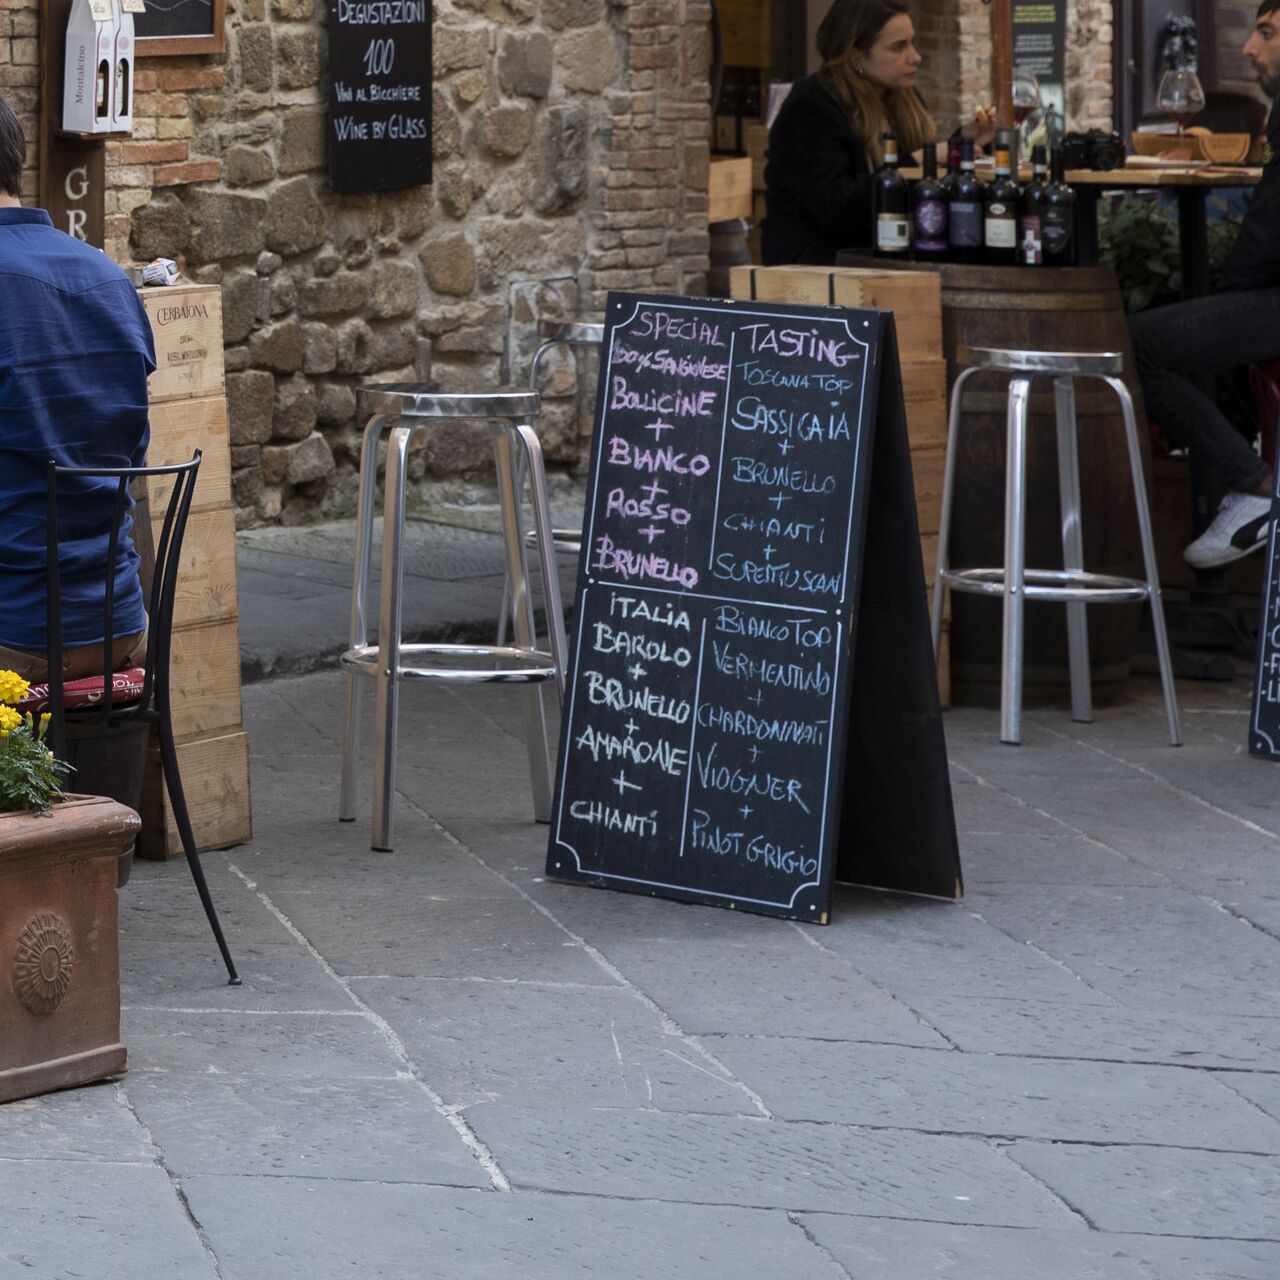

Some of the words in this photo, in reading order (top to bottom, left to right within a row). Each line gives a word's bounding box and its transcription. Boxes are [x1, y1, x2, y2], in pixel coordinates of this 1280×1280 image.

[74, 44, 86, 105] Montalcino
[363, 39, 395, 75] 100
[356, 86, 367, 101] AL
[370, 84, 421, 102] BICCHIERE
[334, 116, 368, 141] WINE
[372, 121, 387, 141] BY
[390, 115, 427, 139] GLASS
[156, 304, 209, 326] CERBAIONA
[629, 311, 726, 347] SPECIAL
[739, 323, 860, 367] TASTING
[610, 375, 718, 417] BOLLICINE
[736, 360, 811, 389] TOSCANA
[811, 373, 854, 396] TOP
[731, 395, 852, 442] SASSICAIA
[606, 434, 711, 477] BIANCO
[730, 456, 837, 495] BRUNELLO
[605, 487, 691, 526] ROSSO
[723, 513, 827, 545] CHIANTI
[592, 533, 700, 590] BRUNELLO
[609, 591, 692, 631] ITALIA
[713, 605, 790, 640] BIANCO
[785, 618, 833, 648] TOP
[592, 621, 692, 667] BAROLO
[712, 640, 832, 696] VERMENTINO
[583, 670, 691, 724] BRUNELLO
[575, 725, 688, 777] AMARONE
[569, 801, 659, 837] CHIANTI
[690, 807, 744, 856] PINOT
[746, 834, 818, 876] GRIGIO
